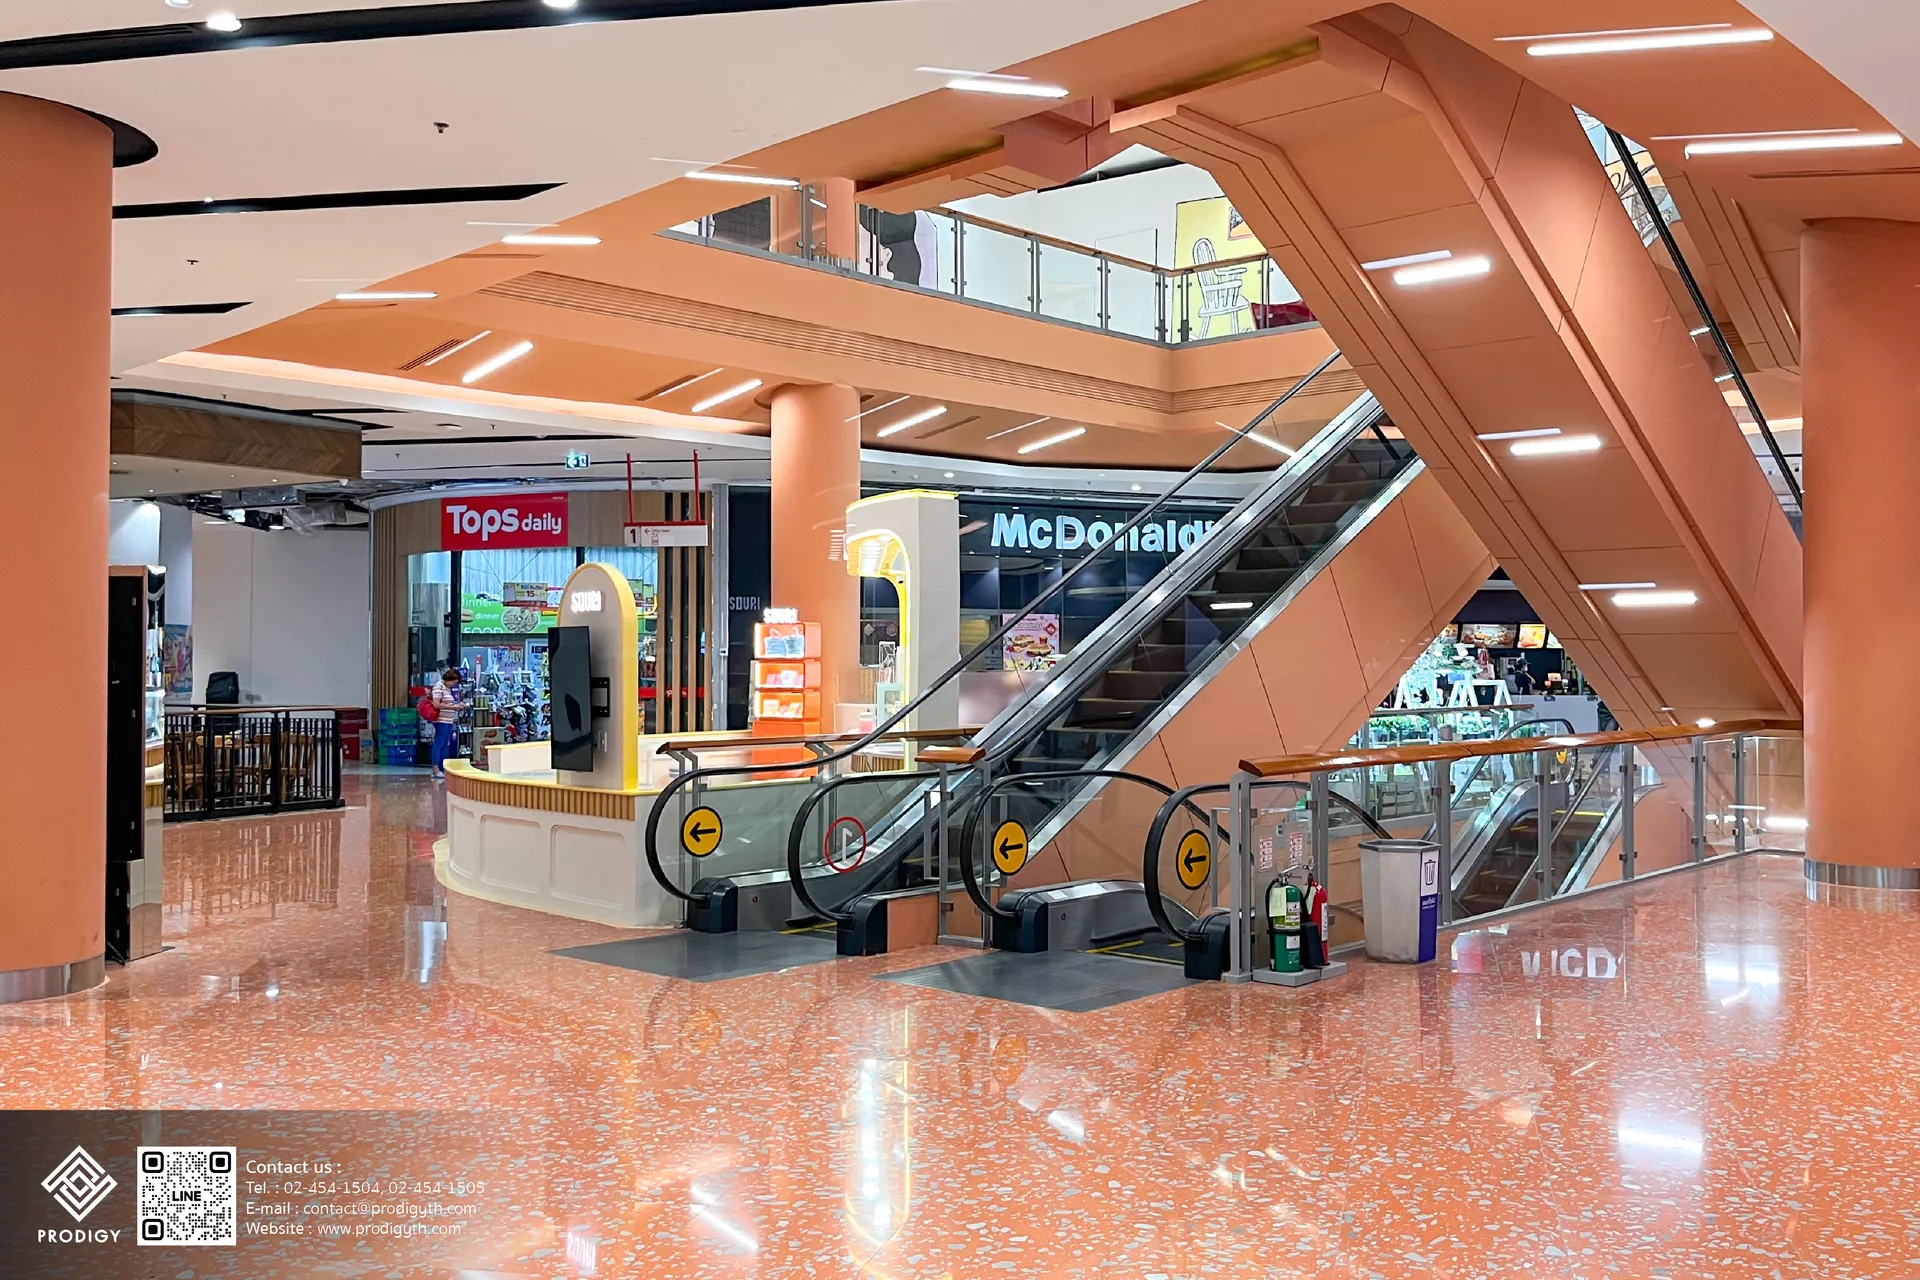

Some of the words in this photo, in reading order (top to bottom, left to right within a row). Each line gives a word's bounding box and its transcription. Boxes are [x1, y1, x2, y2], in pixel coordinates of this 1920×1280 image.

[446, 505, 520, 541] Tops
[521, 513, 562, 535] daily
[629, 528, 637, 544] 1
[729, 596, 760, 610] SOURI
[475, 612, 500, 620] dinner
